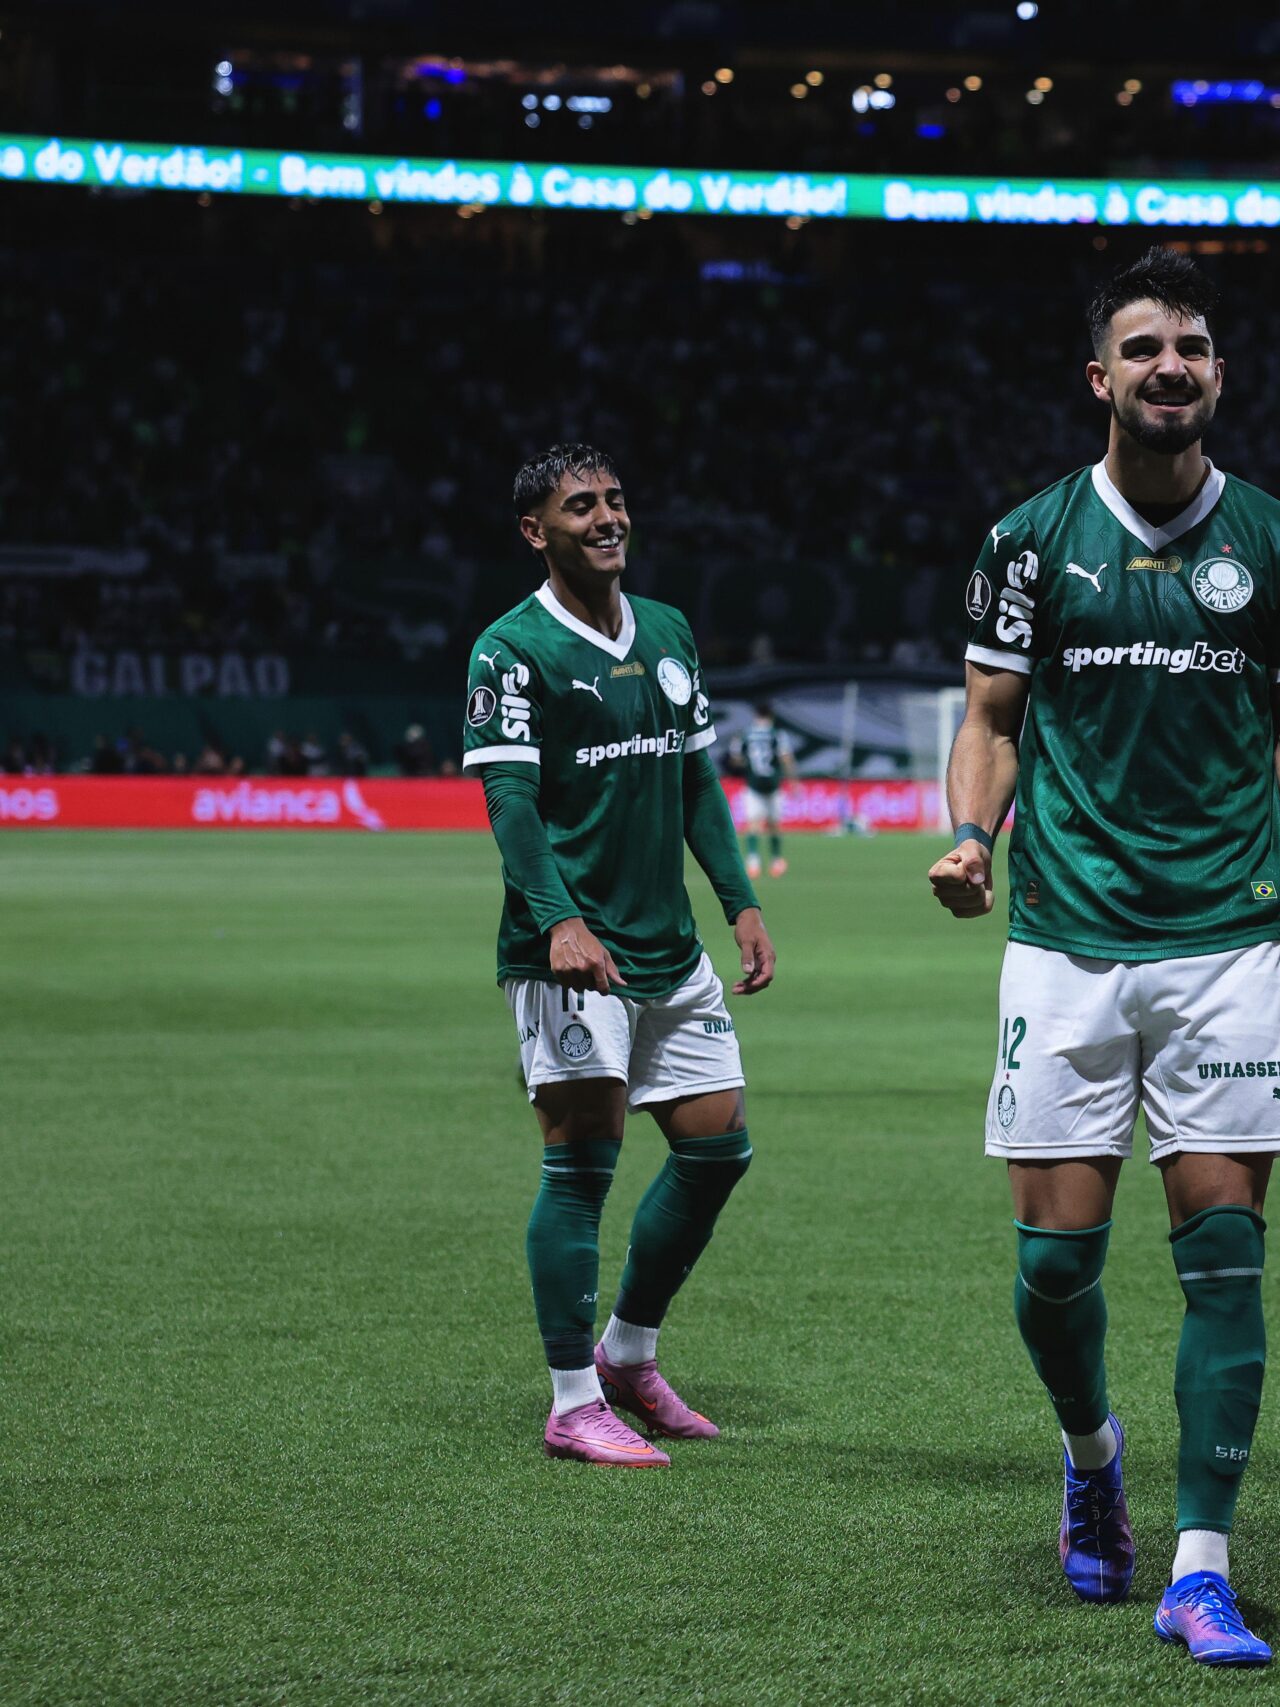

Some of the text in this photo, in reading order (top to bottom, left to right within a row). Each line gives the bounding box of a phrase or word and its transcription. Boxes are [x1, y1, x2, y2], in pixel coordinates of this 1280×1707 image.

[34, 140, 85, 181] do
[279, 155, 367, 196] Bem
[374, 160, 502, 203] vindos
[540, 166, 638, 209] Casa
[643, 169, 694, 210] do
[884, 181, 970, 220] Bem
[975, 183, 1098, 223] vindos
[1135, 186, 1230, 224] Casa
[1131, 558, 1166, 570] AVANTI
[1196, 577, 1250, 609] PALMEIRAS
[1062, 640, 1246, 674] sportingbet
[192, 780, 341, 822] avianca
[1002, 1016, 1027, 1071] 12
[1215, 1445, 1248, 1461] SEP
